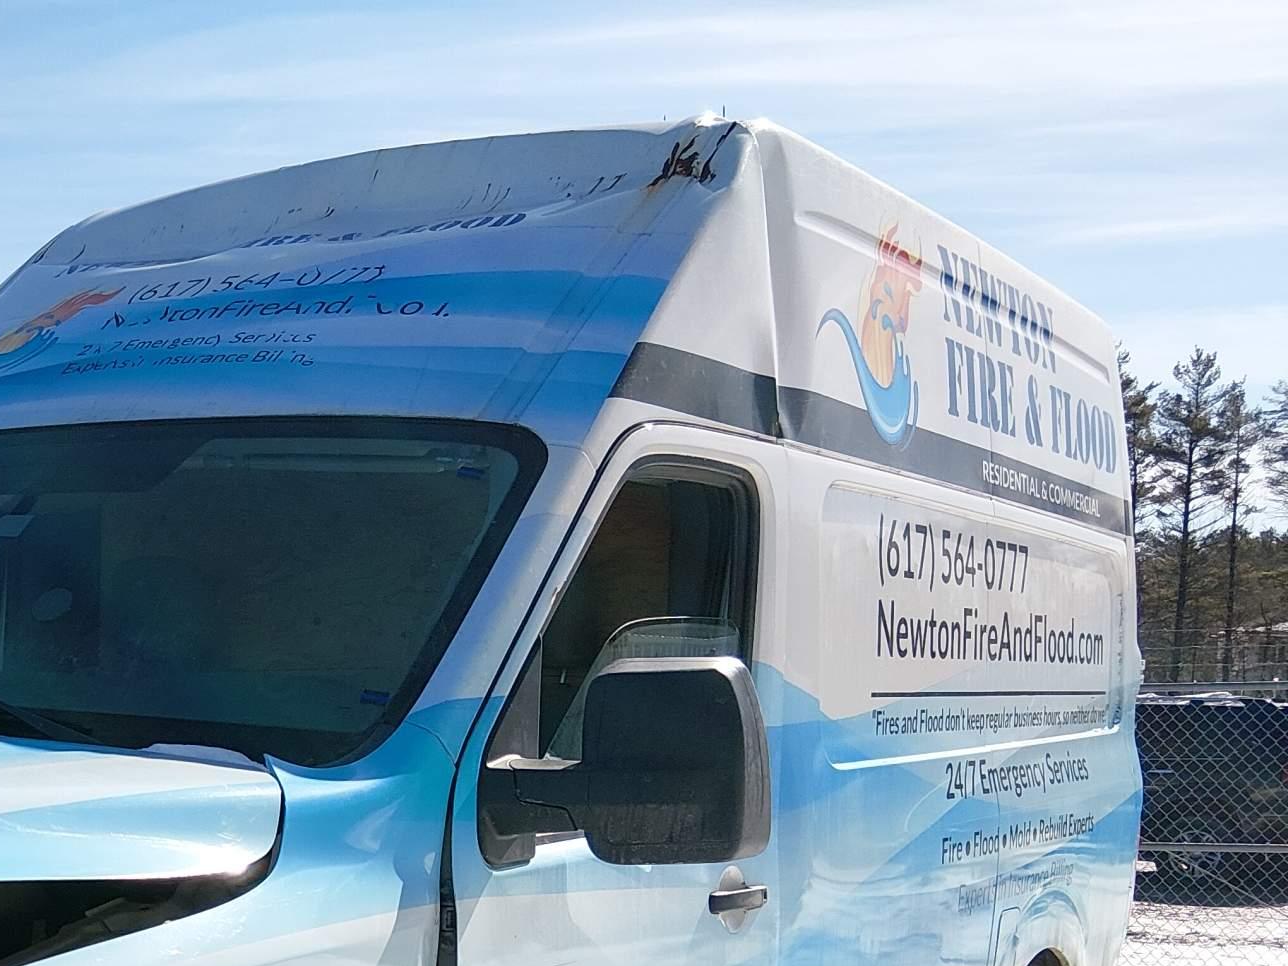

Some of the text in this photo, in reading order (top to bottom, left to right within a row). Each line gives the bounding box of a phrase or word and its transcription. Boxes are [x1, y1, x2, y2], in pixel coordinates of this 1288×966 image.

[128, 277, 211, 304] (617)
[937, 244, 1056, 373] NEWTON
[945, 336, 1117, 475] FIRE & FLOOD
[982, 460, 1101, 518] RESIDENTIAL & COMMERCIAL
[878, 512, 1029, 594] (617) 564-0777
[877, 599, 1104, 665] NewtonFireAndFlood.com
[901, 709, 918, 734] and
[919, 709, 944, 733] Flood
[945, 707, 966, 732] don't
[967, 709, 985, 735] keep
[985, 706, 1012, 733] regular
[1014, 706, 1042, 728] business
[945, 751, 1089, 799] 24/7 Emergency Services
[941, 812, 1095, 865] Fire Flood Mold Rebuild Experts
